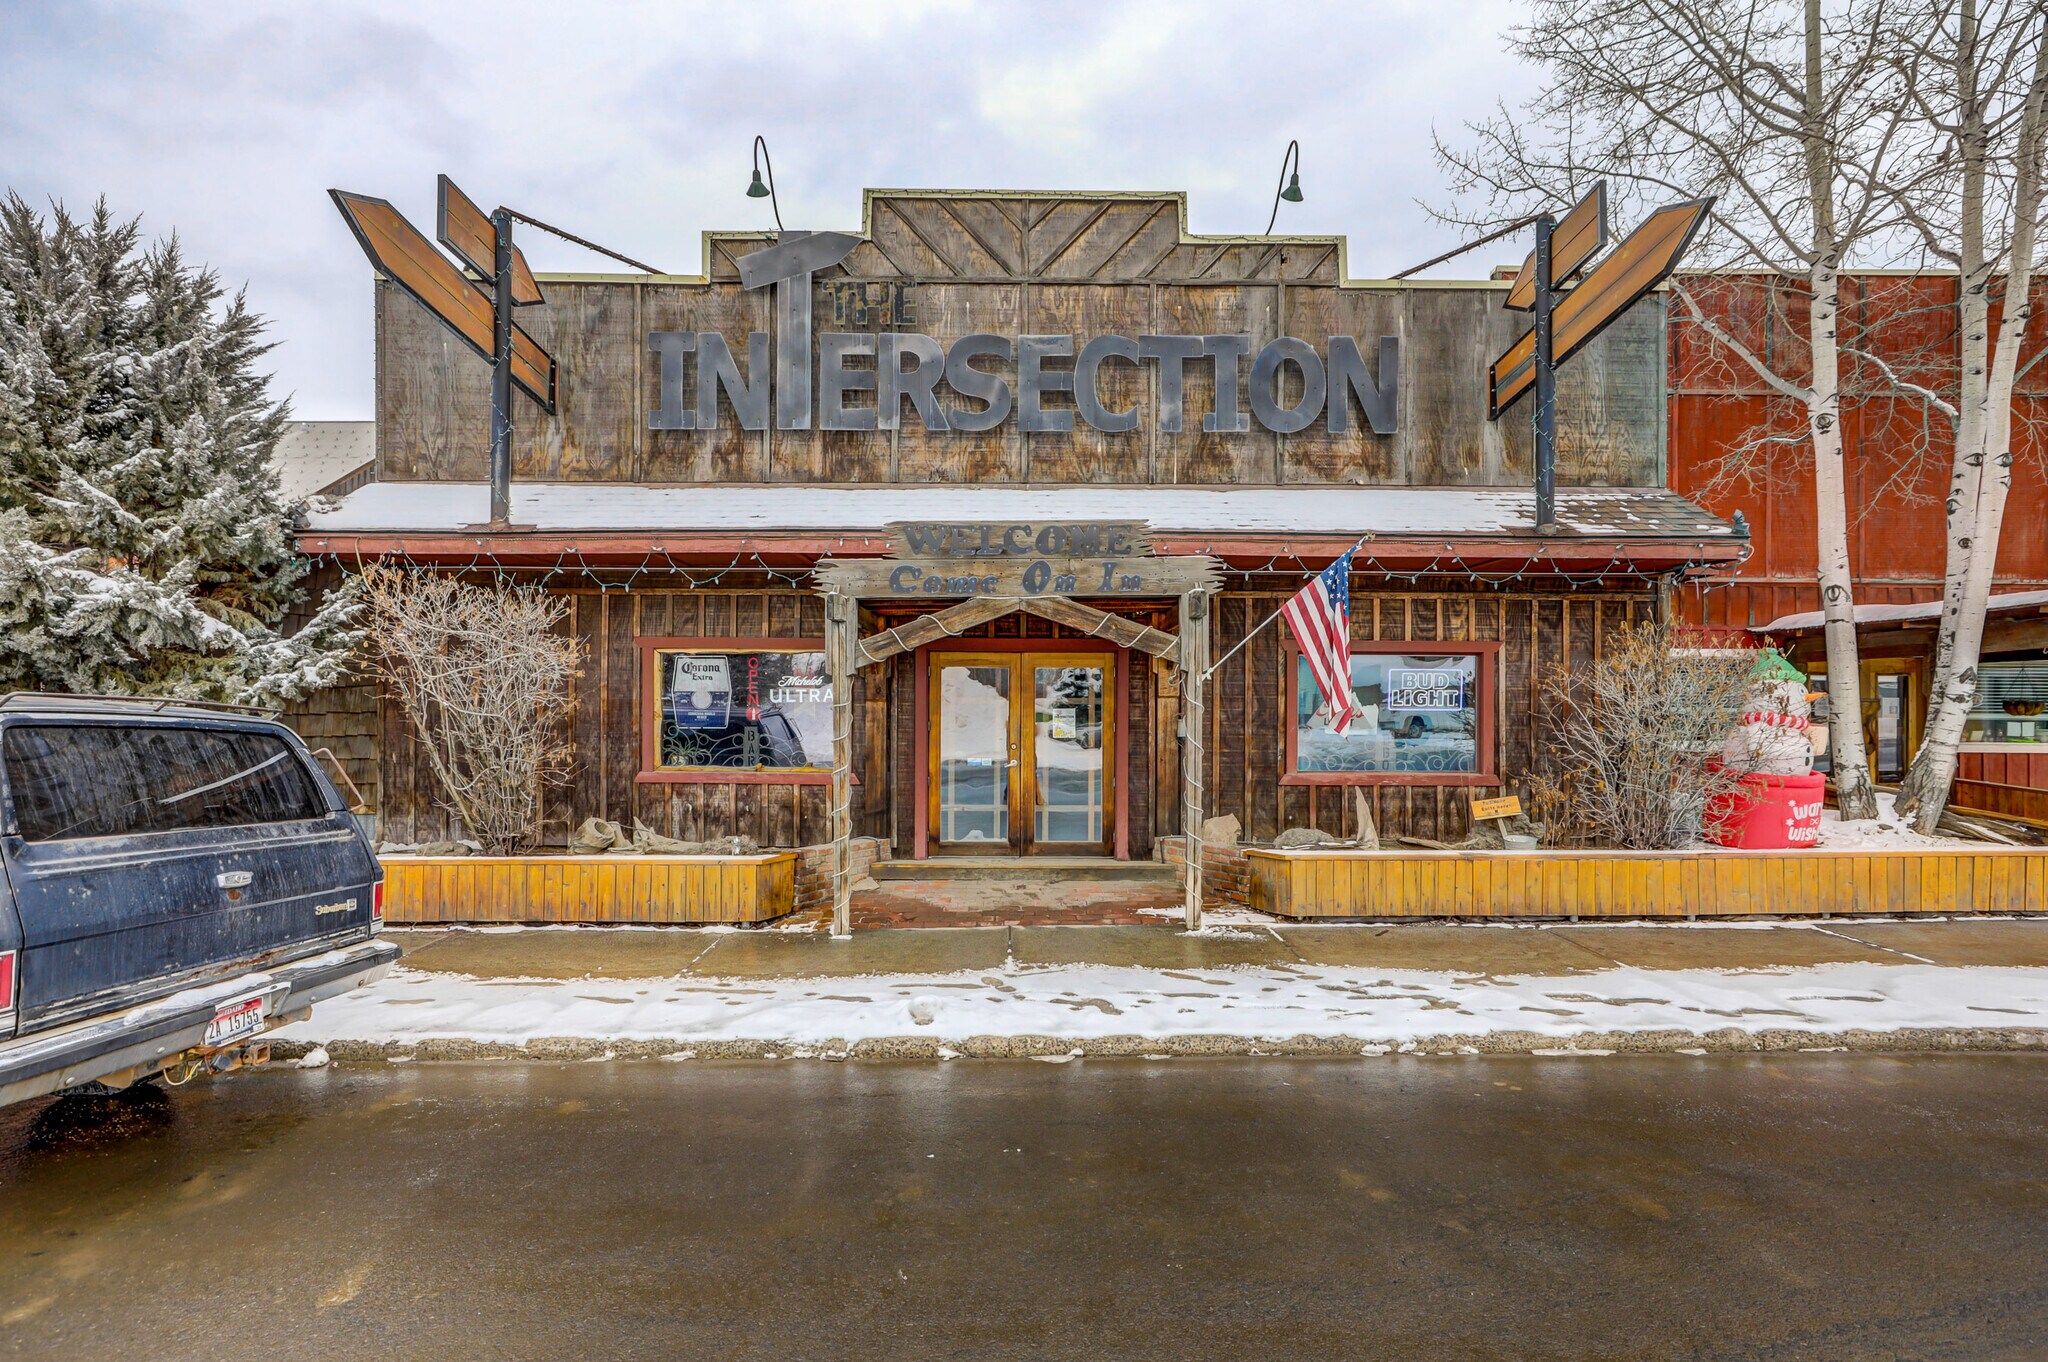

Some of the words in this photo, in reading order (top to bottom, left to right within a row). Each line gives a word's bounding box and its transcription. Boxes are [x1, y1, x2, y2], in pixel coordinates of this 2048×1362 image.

[821, 280, 918, 325] THE
[648, 231, 1399, 434] INTERSECTION
[903, 524, 1133, 556] WELCOME
[889, 563, 999, 594] Come
[1022, 560, 1076, 594] On
[1097, 561, 1142, 592] In
[681, 661, 721, 674] Corona
[692, 673, 713, 681] Extra
[747, 656, 759, 706] OPEN
[777, 675, 825, 687] Michelob
[1402, 672, 1450, 689] BUD
[769, 688, 833, 703] ULTRA
[209, 1021, 221, 1040] 2A
[228, 1007, 259, 1033] 15755
